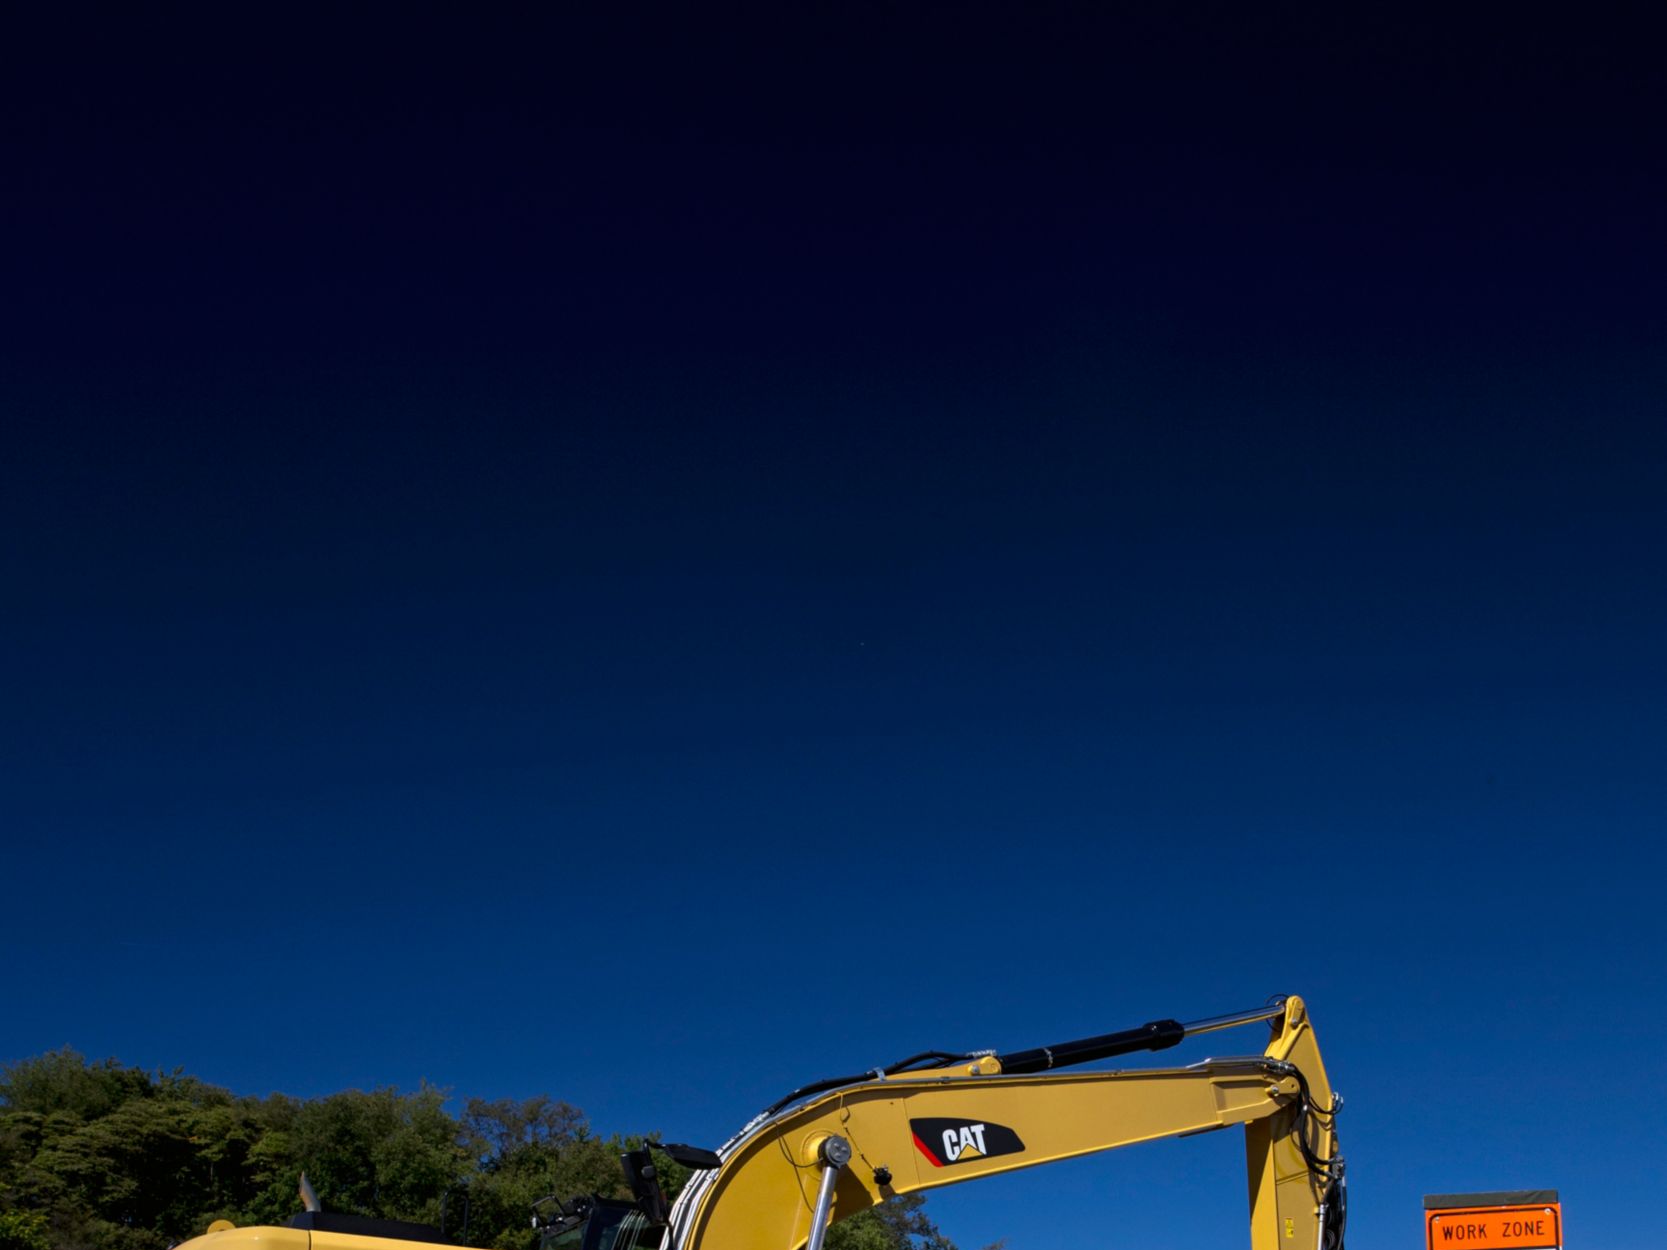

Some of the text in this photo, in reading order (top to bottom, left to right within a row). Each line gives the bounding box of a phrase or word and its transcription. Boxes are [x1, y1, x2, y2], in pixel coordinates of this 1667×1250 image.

[942, 1124, 987, 1161] CAT
[1442, 1220, 1545, 1241] WORK ZONE
